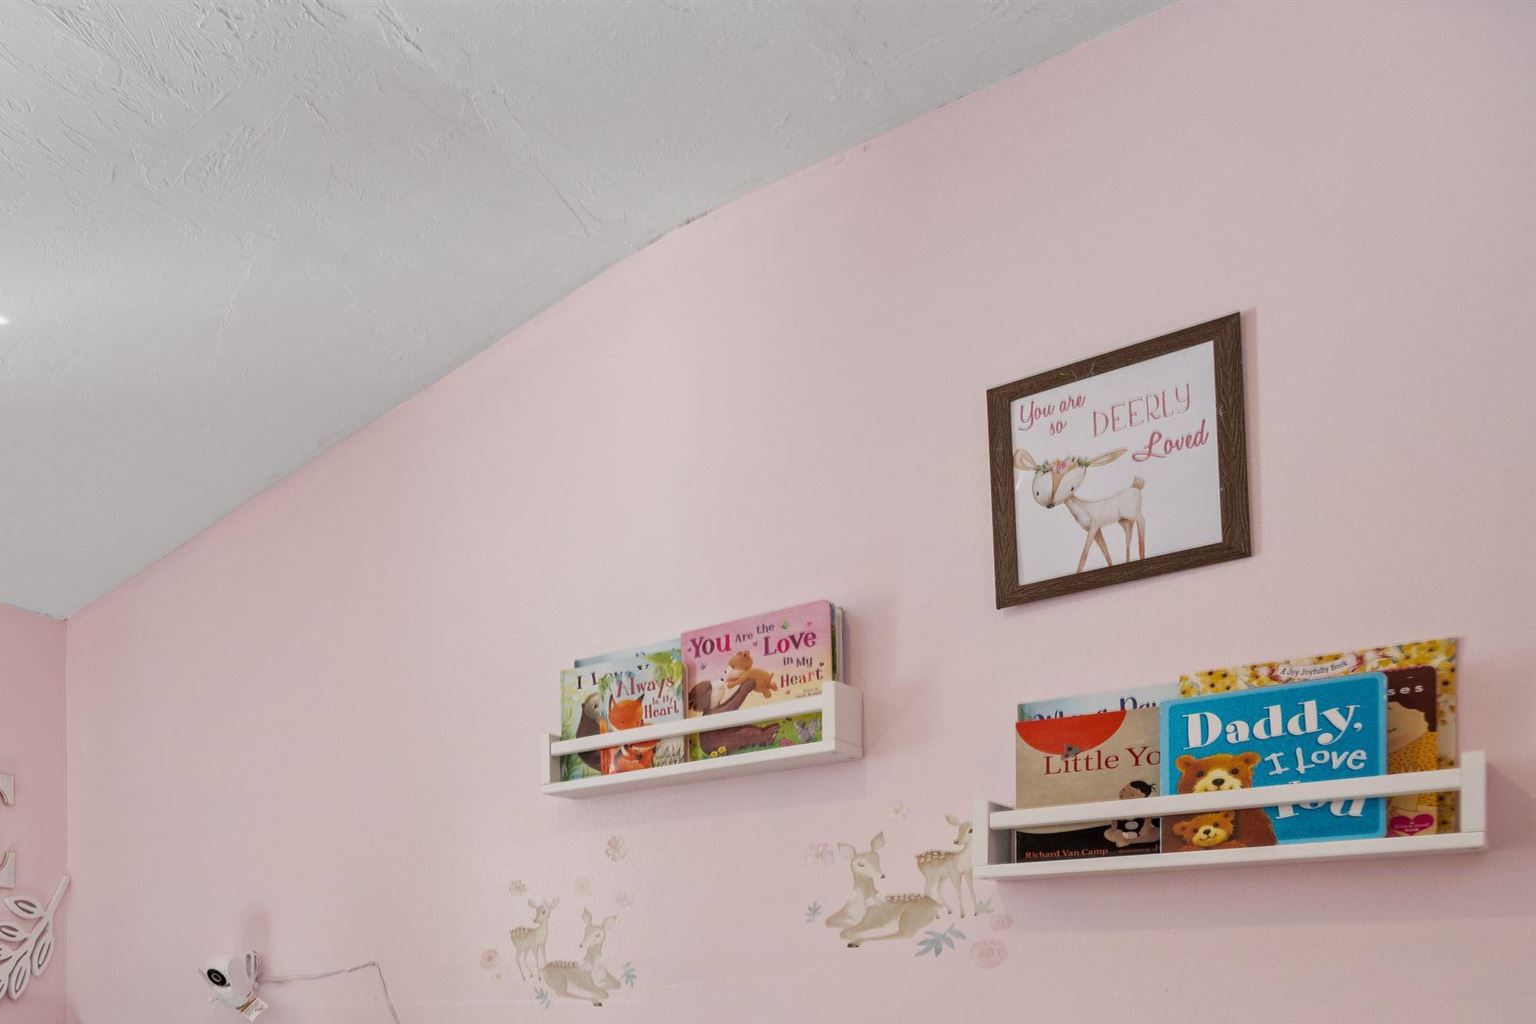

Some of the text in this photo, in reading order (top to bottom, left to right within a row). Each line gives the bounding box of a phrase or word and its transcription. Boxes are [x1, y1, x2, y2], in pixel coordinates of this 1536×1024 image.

[1018, 393, 1086, 431] You are
[1092, 383, 1191, 437] DEERLY
[1049, 420, 1068, 436] so
[1131, 419, 1209, 462] Loved
[689, 623, 775, 659] You Are the
[763, 631, 817, 656] Love
[796, 657, 813, 667] My
[1330, 661, 1348, 671] Book
[616, 676, 675, 698] Always
[780, 667, 824, 688] Heart
[1387, 684, 1424, 696] ses
[644, 700, 680, 719] Heart
[1182, 699, 1363, 750] Daddy,
[1042, 745, 1161, 776] Little Yo
[1264, 747, 1368, 776] I Love
[1025, 850, 1060, 859] Richard
[1062, 849, 1080, 857] Van
[1081, 848, 1109, 858] Camp
